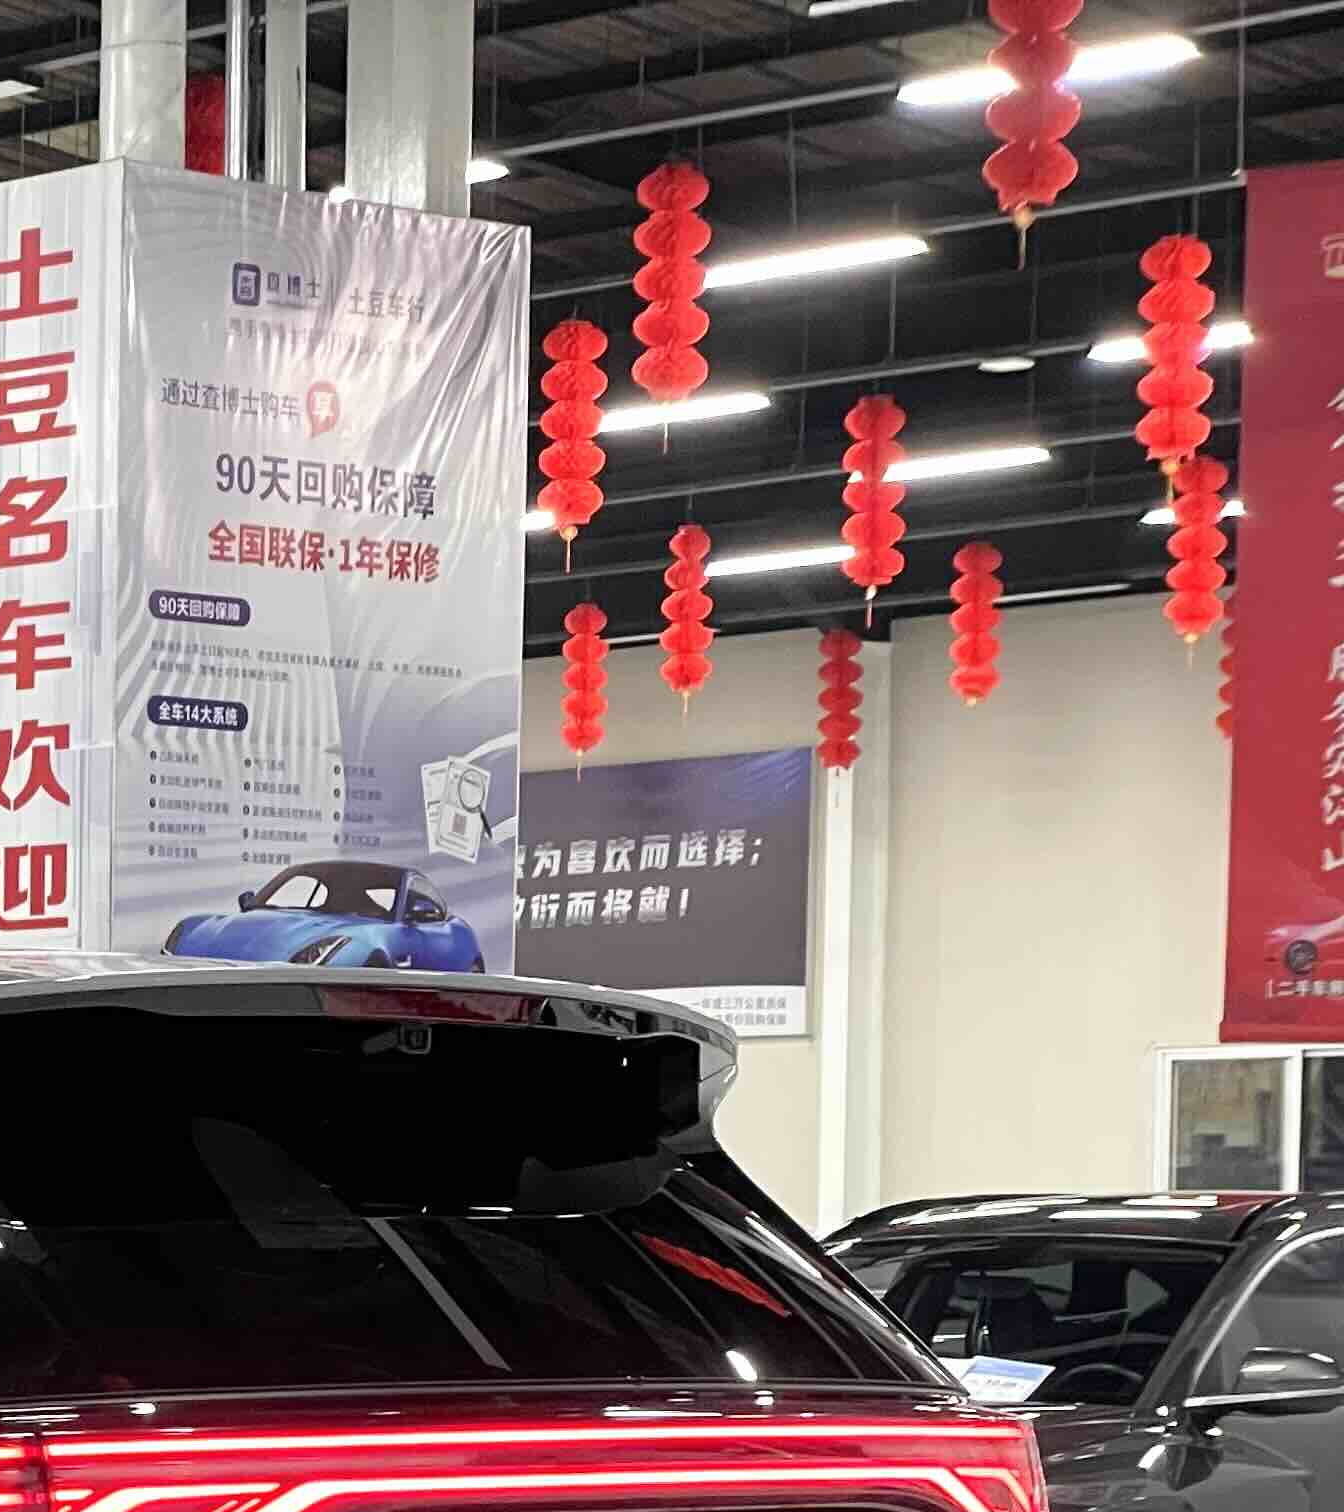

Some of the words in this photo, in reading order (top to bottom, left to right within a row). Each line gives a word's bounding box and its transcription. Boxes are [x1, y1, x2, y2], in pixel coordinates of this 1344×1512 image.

[348, 288, 425, 324] 土豆车行
[216, 453, 437, 520] 90天回购保障
[159, 597, 240, 621] 90天回购保障
[159, 702, 238, 726] 全车14大系统
